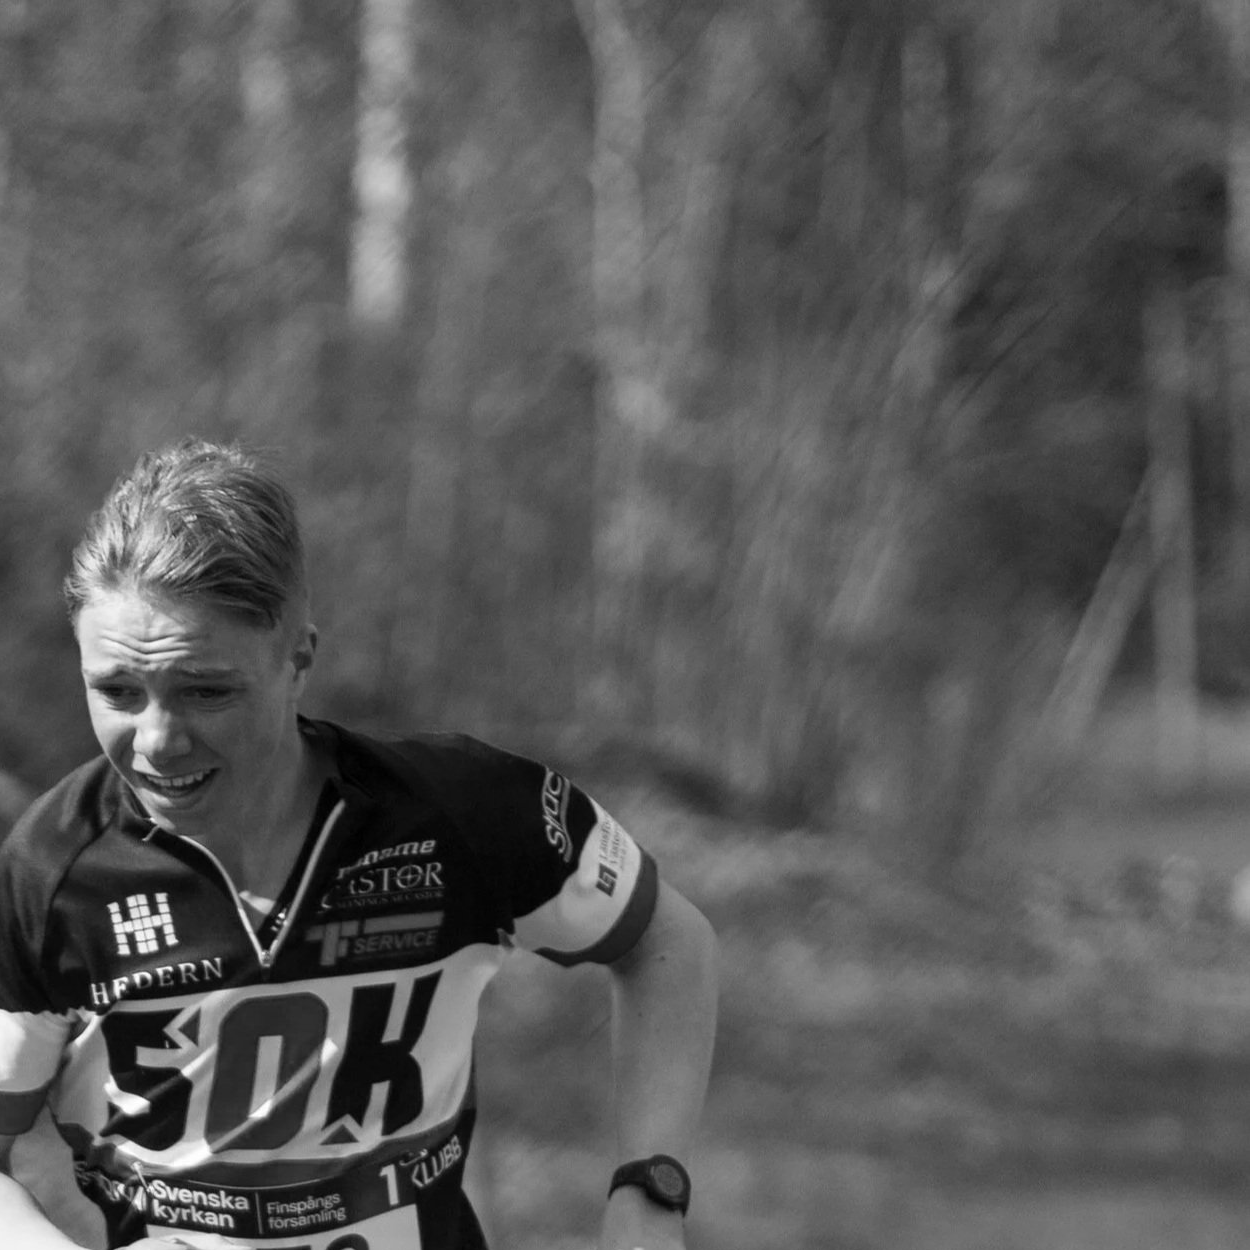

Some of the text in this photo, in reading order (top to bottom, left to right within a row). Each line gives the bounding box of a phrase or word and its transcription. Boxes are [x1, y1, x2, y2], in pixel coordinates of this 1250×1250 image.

[352, 929, 438, 955] SERVICE
[150, 1179, 250, 1211] Svenska
[378, 1163, 399, 1207] 1
[152, 1198, 235, 1229] kyrkan
[266, 1192, 342, 1215] Finspångs
[267, 1206, 348, 1230] församling
